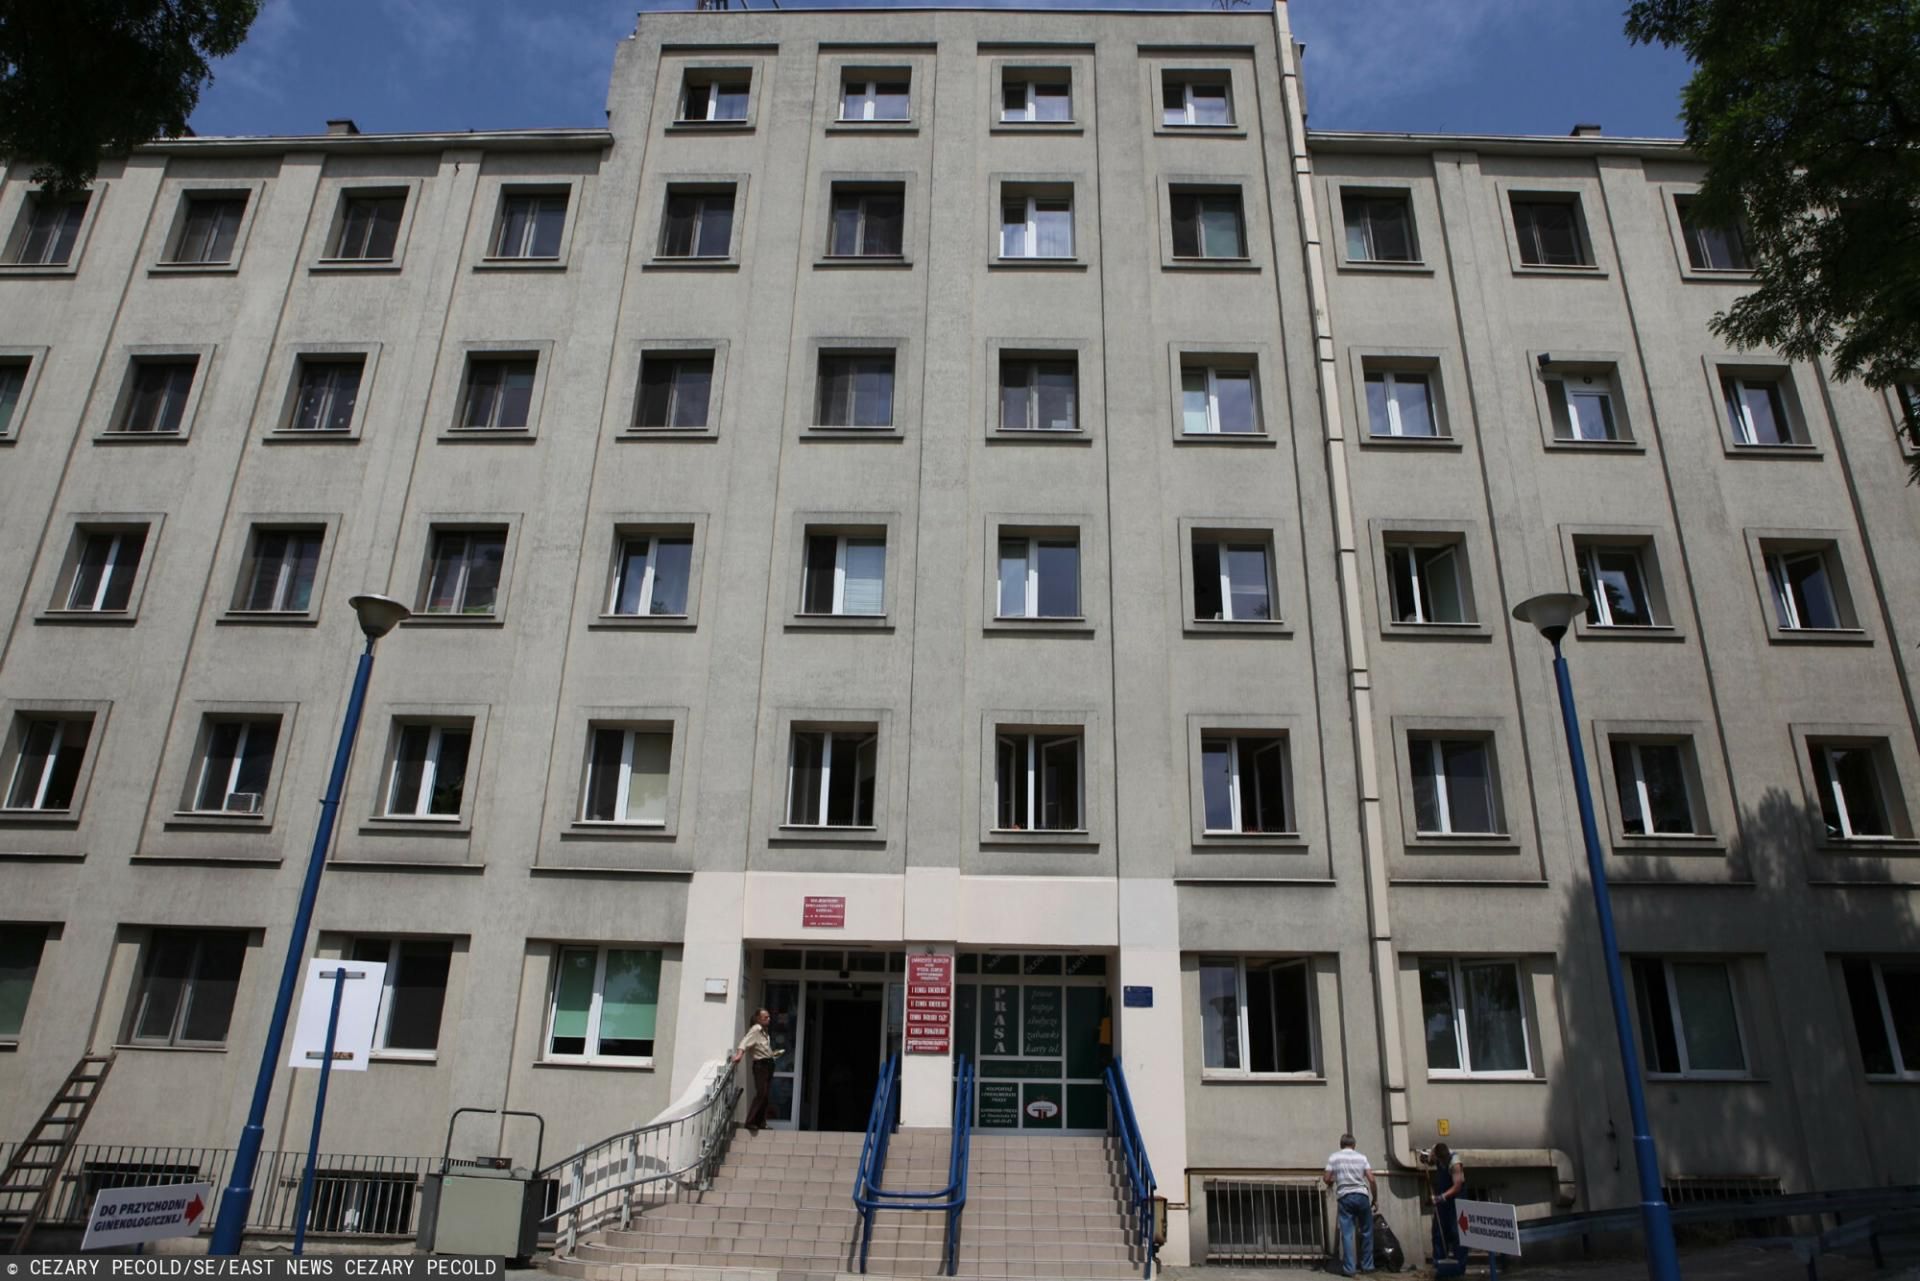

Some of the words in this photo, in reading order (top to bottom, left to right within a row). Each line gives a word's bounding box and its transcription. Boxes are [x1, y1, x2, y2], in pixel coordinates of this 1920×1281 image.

[992, 987, 1007, 1054] PRASA
[99, 1204, 117, 1217] DO
[119, 1198, 187, 1215] PRZYCHODNI
[94, 1213, 183, 1232] GINEKOLOGICZNEJ
